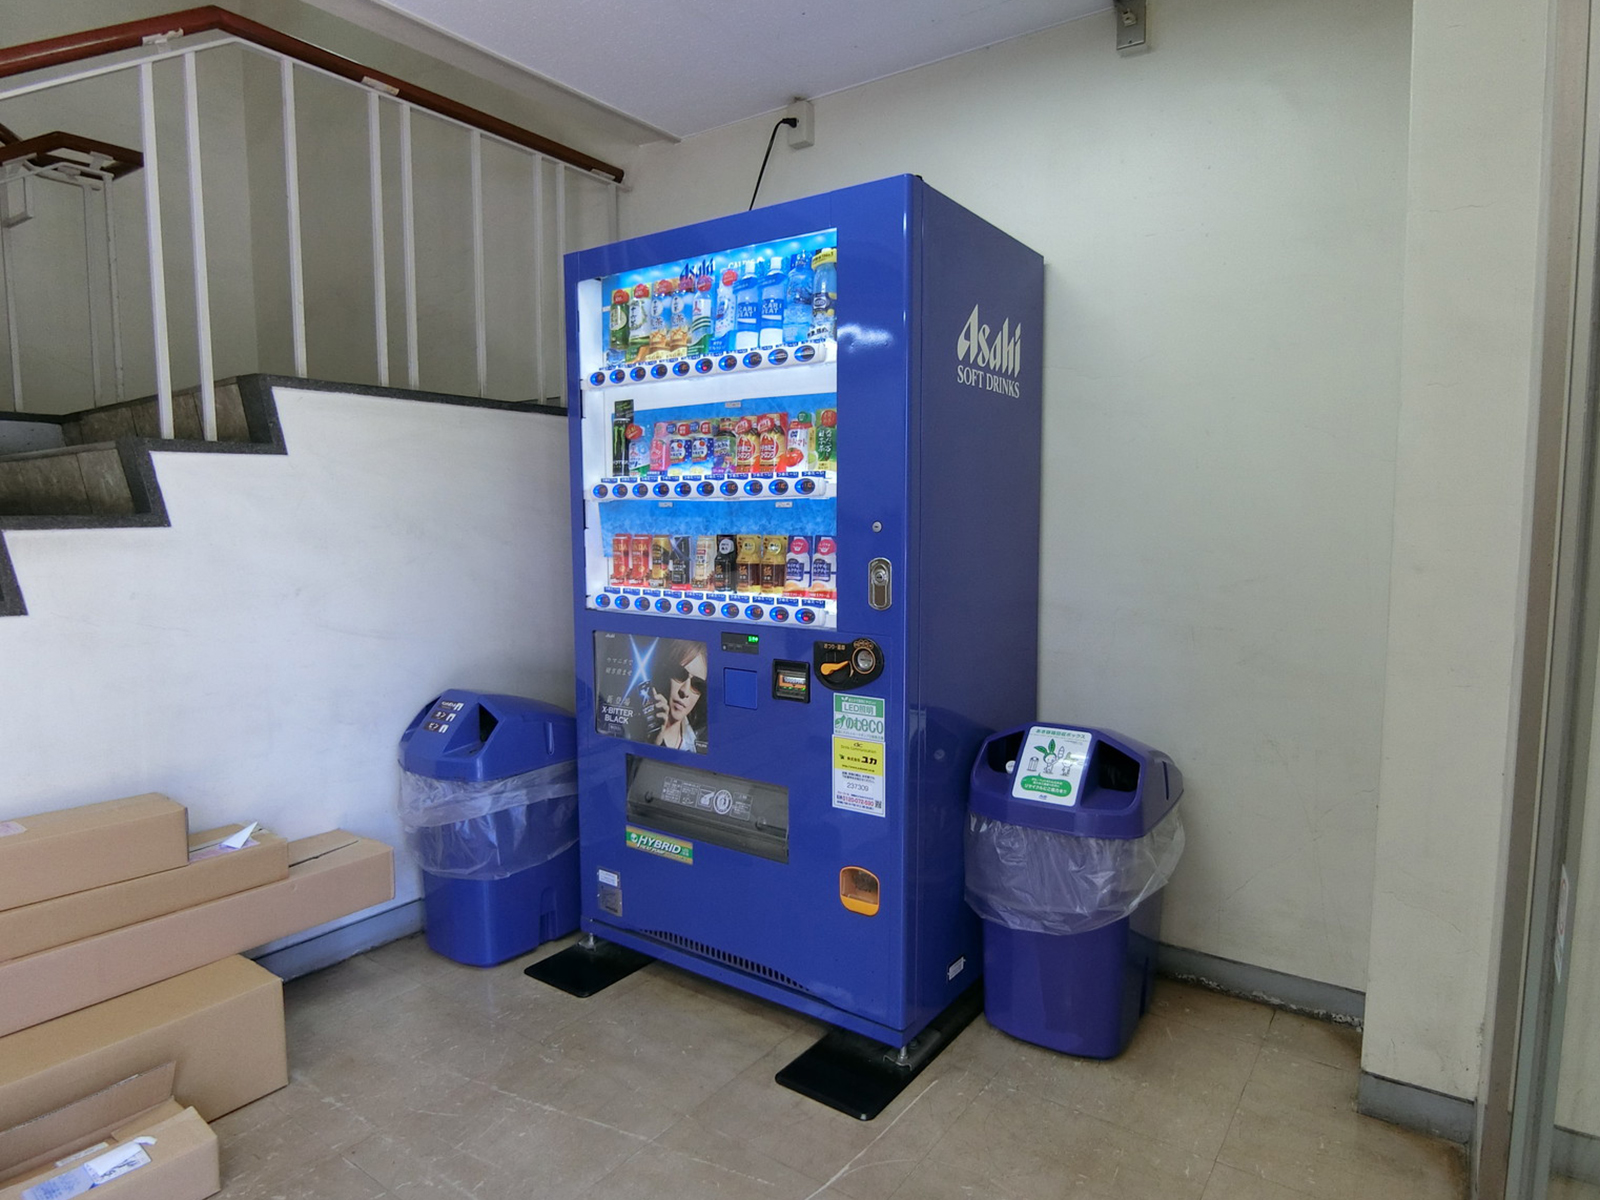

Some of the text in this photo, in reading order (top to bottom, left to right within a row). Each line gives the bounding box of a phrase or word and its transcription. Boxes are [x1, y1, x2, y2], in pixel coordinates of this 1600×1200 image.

[680, 257, 716, 280] Asahi
[957, 303, 1021, 378] Asahi
[957, 364, 1020, 399] SOFT DRINKS
[601, 706, 634, 717] X-BITTER
[844, 703, 874, 715] LED照明
[604, 714, 629, 725] BLACK
[861, 756, 877, 765] ユカ
[847, 782, 869, 791] 237309
[636, 834, 681, 854] HYBRID
